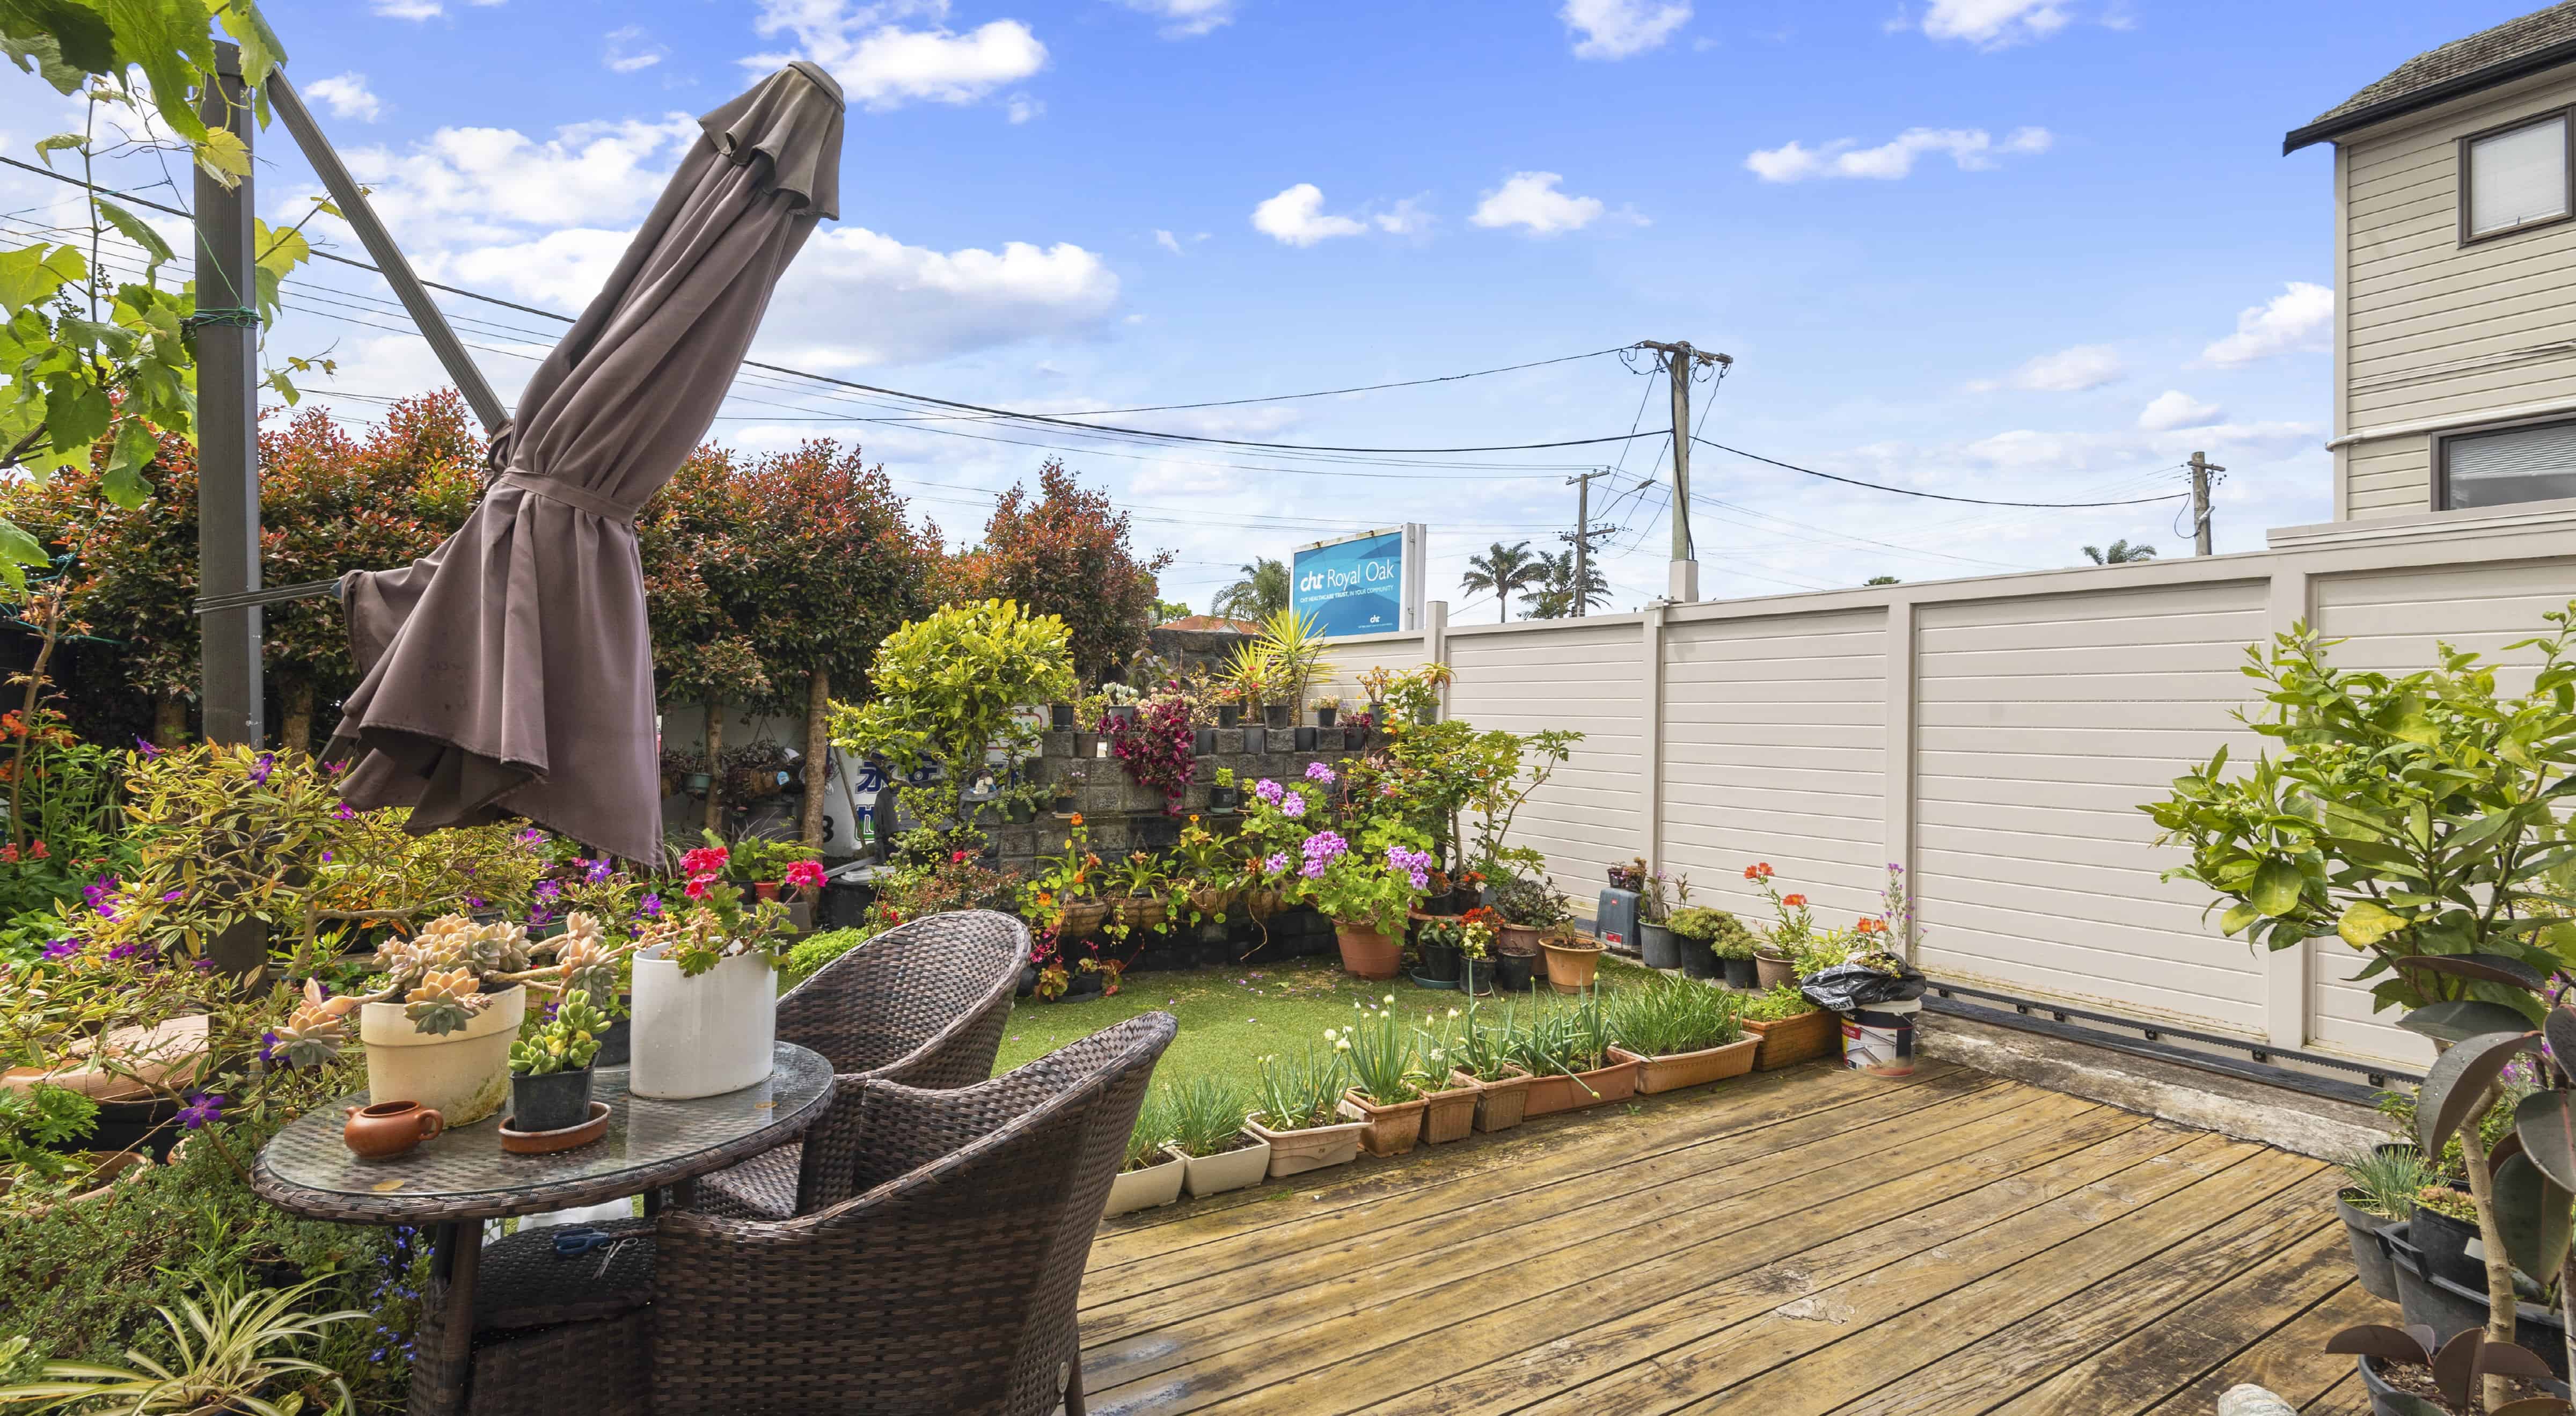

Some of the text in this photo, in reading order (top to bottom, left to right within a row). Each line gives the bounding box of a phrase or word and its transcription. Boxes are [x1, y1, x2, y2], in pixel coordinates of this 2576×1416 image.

[1300, 559, 1394, 592] cht Royal Oak
[1367, 584, 1394, 593] COMMUNITY
[1370, 615, 1380, 623] cht
